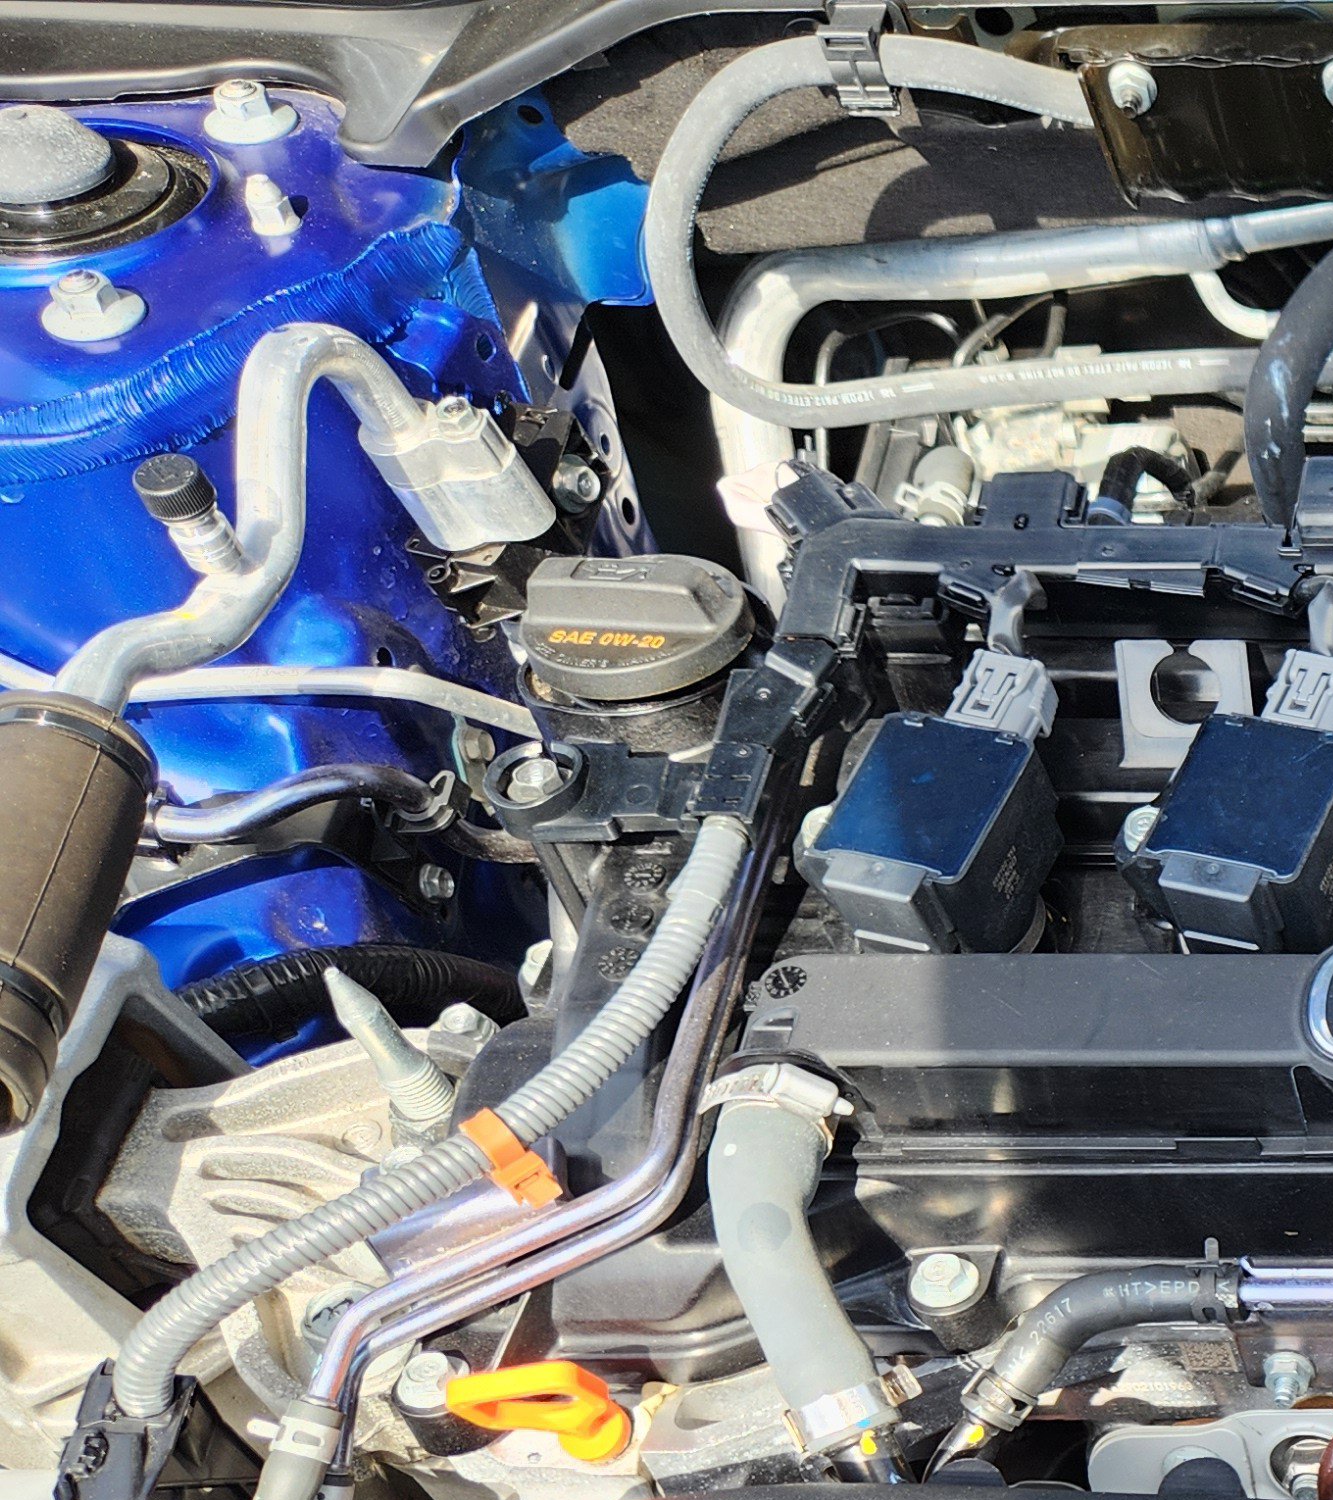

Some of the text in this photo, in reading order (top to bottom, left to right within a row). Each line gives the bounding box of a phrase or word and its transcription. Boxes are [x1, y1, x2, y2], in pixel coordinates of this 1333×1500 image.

[548, 629, 666, 650] SAE 0W-20
[1117, 1279, 1232, 1299] HT>EPD<
